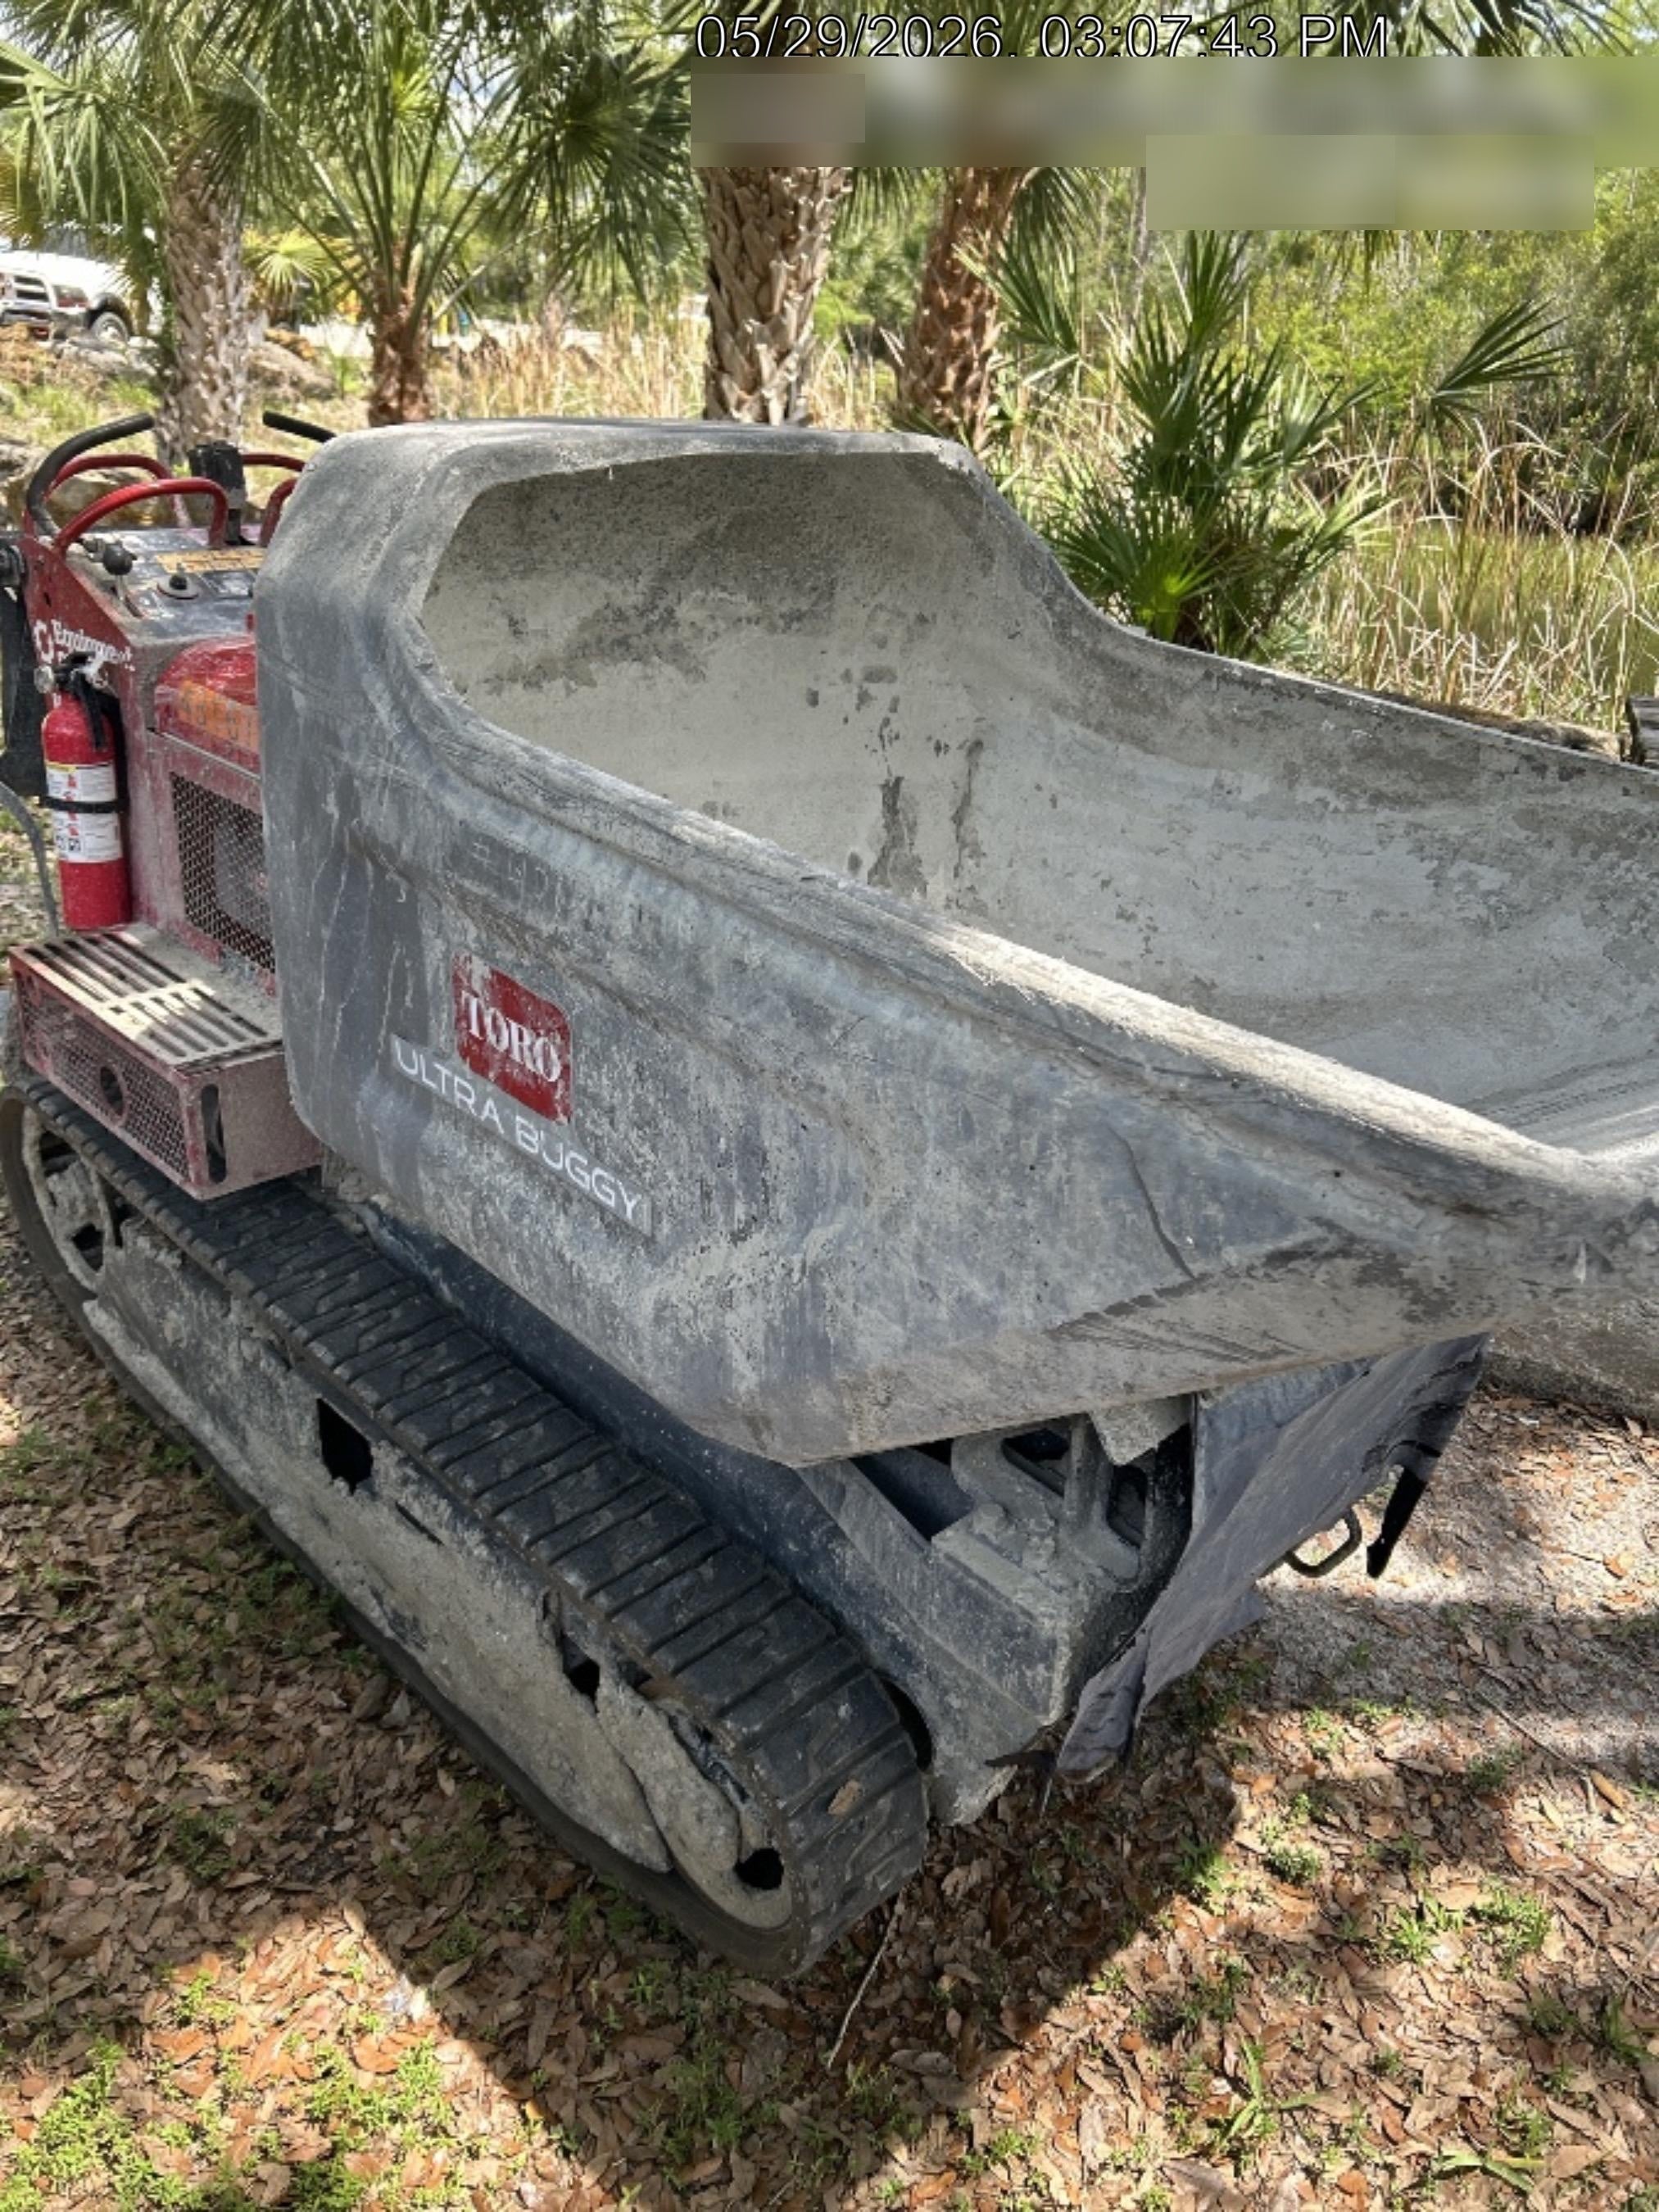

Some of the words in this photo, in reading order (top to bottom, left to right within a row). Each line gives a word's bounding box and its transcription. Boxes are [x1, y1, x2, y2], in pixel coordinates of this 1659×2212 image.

[460, 990, 563, 1082] TORO
[393, 1040, 505, 1134] ULTRA
[515, 1115, 641, 1221] BUGGY
